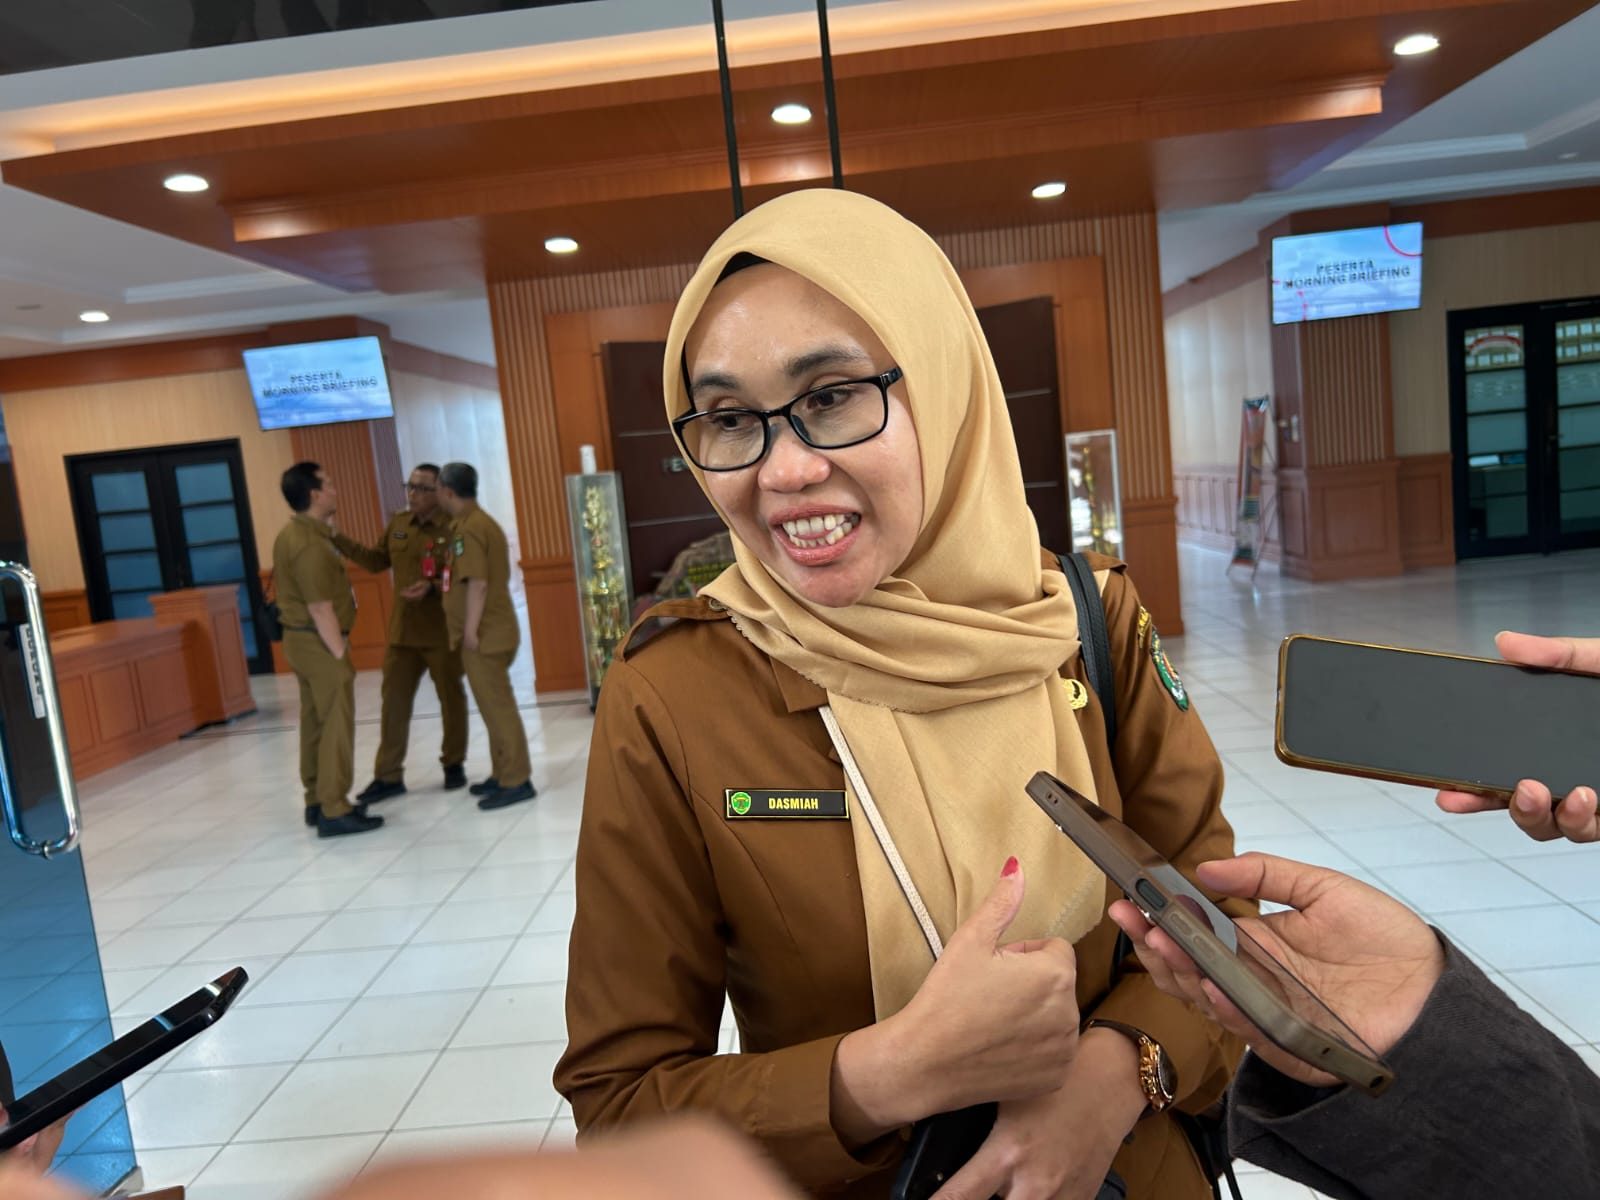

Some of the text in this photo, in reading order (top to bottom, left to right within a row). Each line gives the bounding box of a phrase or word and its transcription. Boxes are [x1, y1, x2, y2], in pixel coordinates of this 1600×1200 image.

[1316, 259, 1374, 275] PESERTA
[1283, 265, 1411, 289] MORNING BRIEFING
[322, 375, 378, 391] BRIEFING
[768, 797, 819, 810] DASMIAH
